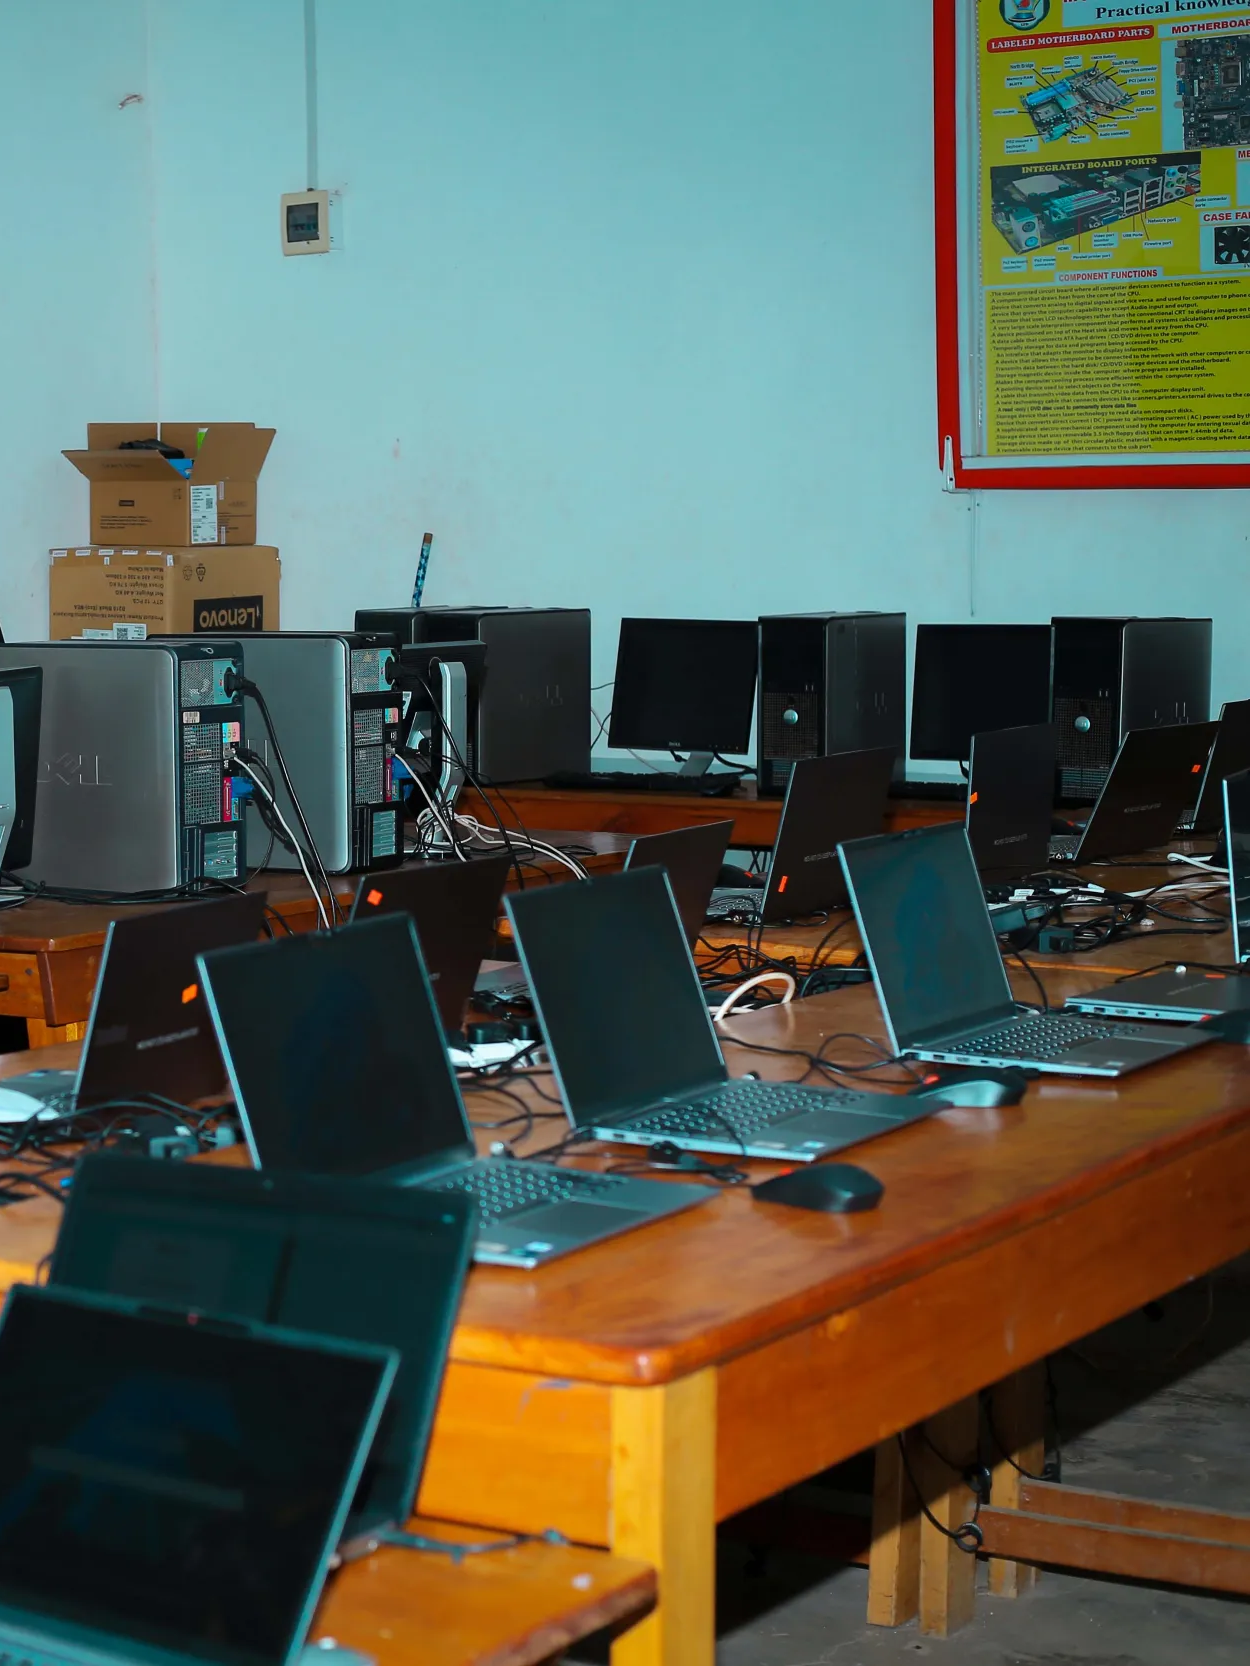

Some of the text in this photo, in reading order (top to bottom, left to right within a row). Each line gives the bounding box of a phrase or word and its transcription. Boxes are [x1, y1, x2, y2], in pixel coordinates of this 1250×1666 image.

[1096, 2, 1170, 19] Practical
[991, 28, 1150, 49] LABELED MOTHERBOARD PARTS
[1021, 157, 1157, 174] INTEGRATED BOARD PORTS
[1203, 212, 1232, 222] CASE
[1059, 269, 1158, 281] COMPONENT FUNCTIONS
[199, 608, 255, 628] Lenovo
